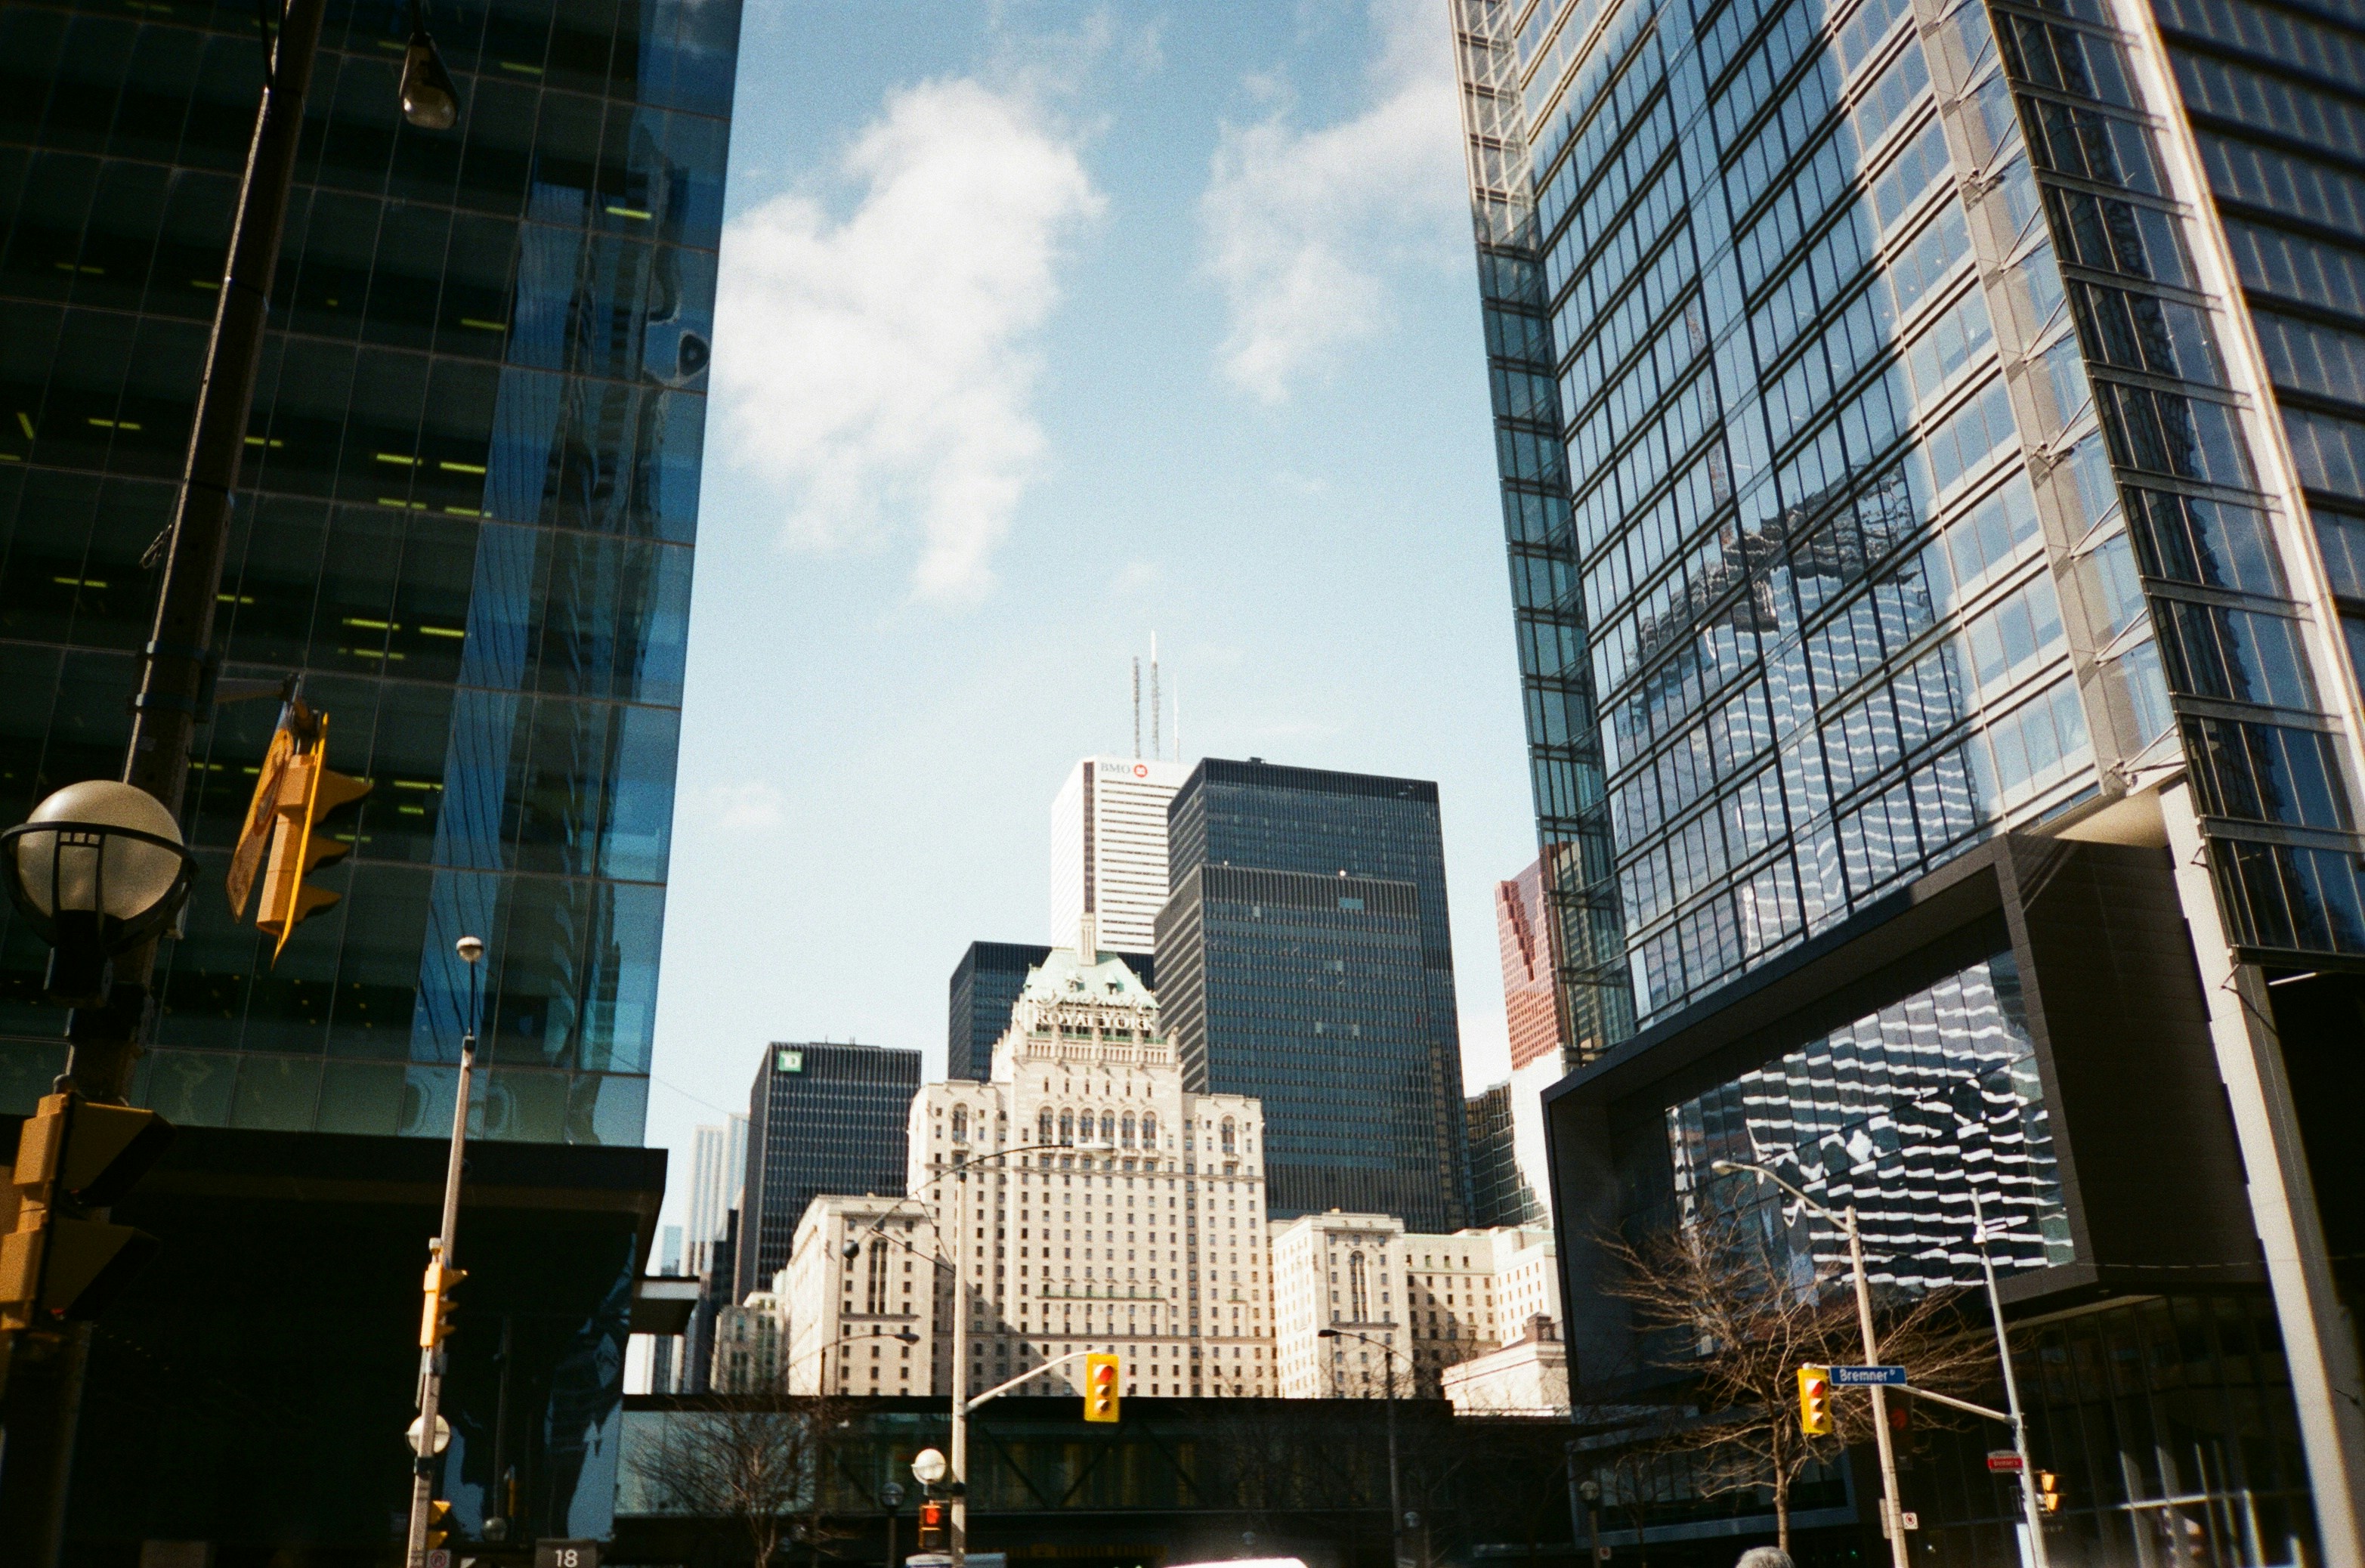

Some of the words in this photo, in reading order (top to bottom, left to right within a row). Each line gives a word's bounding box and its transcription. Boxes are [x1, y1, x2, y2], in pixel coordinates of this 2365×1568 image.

[1101, 762, 1130, 774] BMO
[1035, 1008, 1095, 1027] ROYAL
[1100, 1011, 1156, 1031] YORK
[781, 1053, 801, 1068] TD
[1839, 1369, 1888, 1382] Bremner
[555, 1549, 578, 1567] 18
